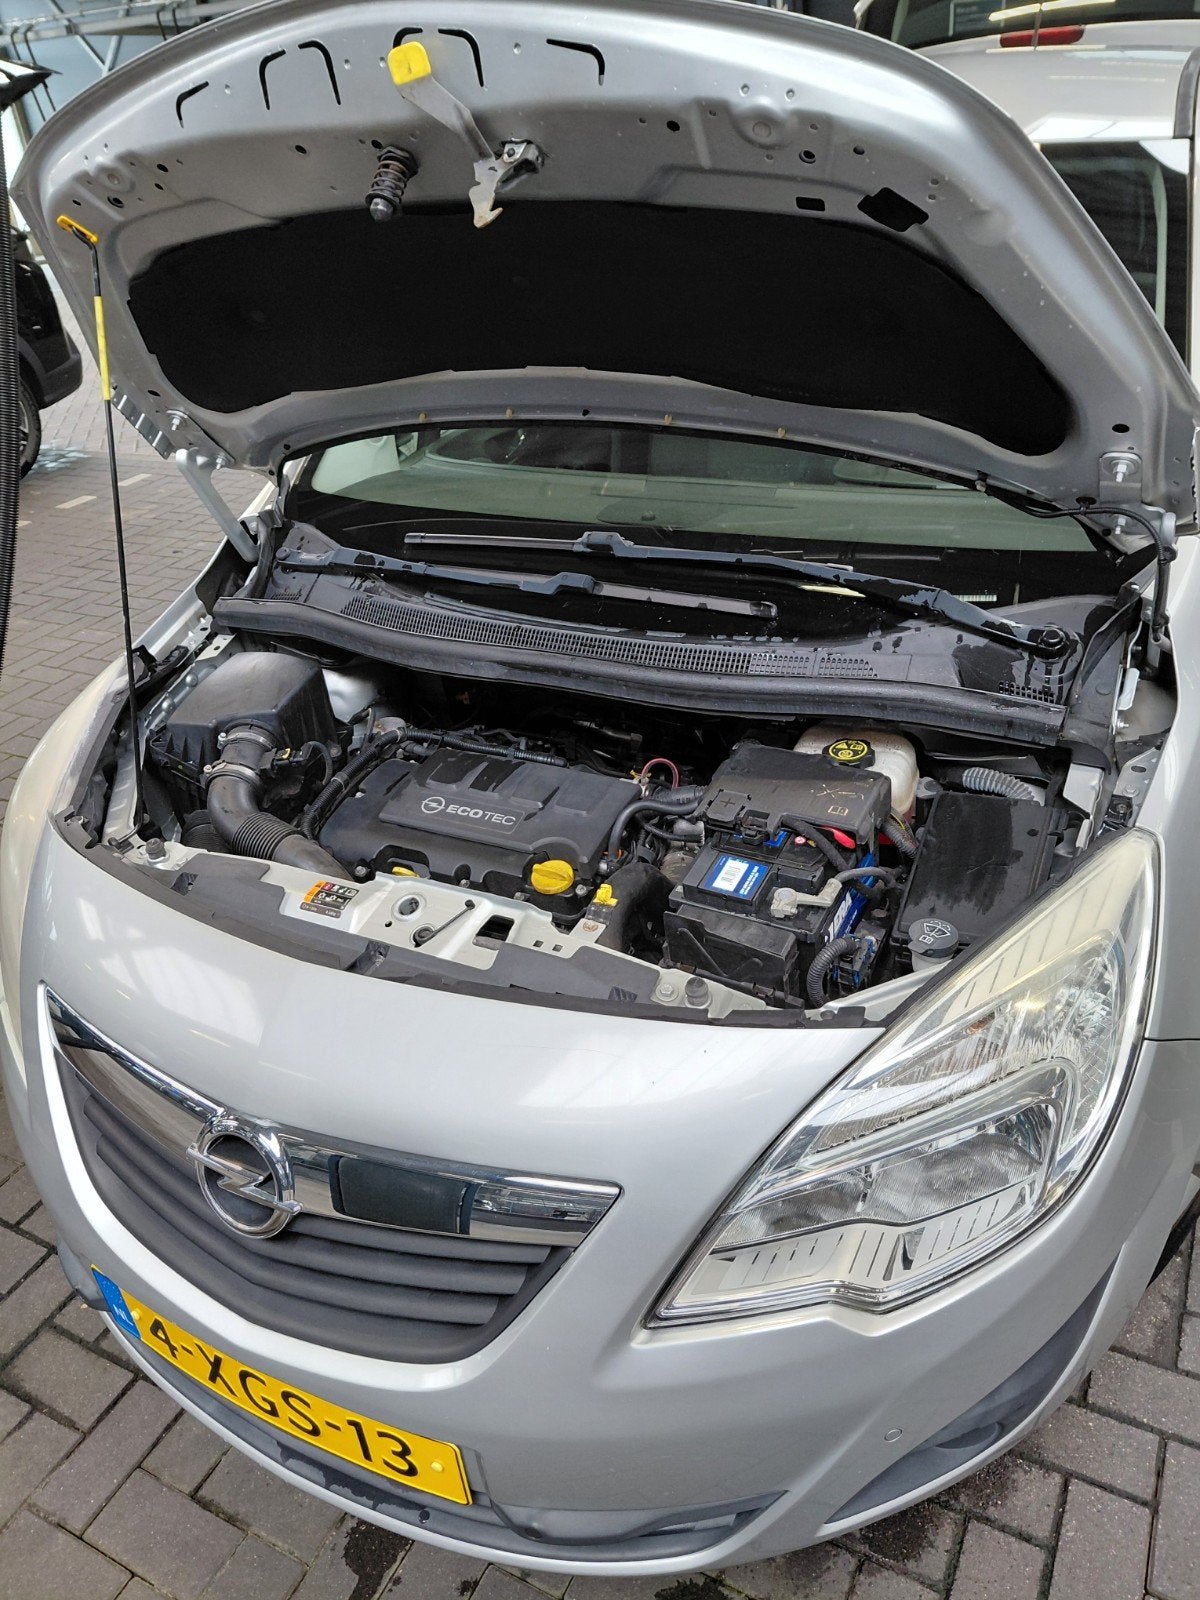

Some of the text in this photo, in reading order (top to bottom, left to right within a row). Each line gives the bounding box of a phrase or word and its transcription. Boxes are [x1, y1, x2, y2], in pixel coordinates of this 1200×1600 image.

[446, 804, 516, 825] ECOTEC
[113, 1304, 134, 1326] NL
[150, 1318, 419, 1478] 4-XGS-13
